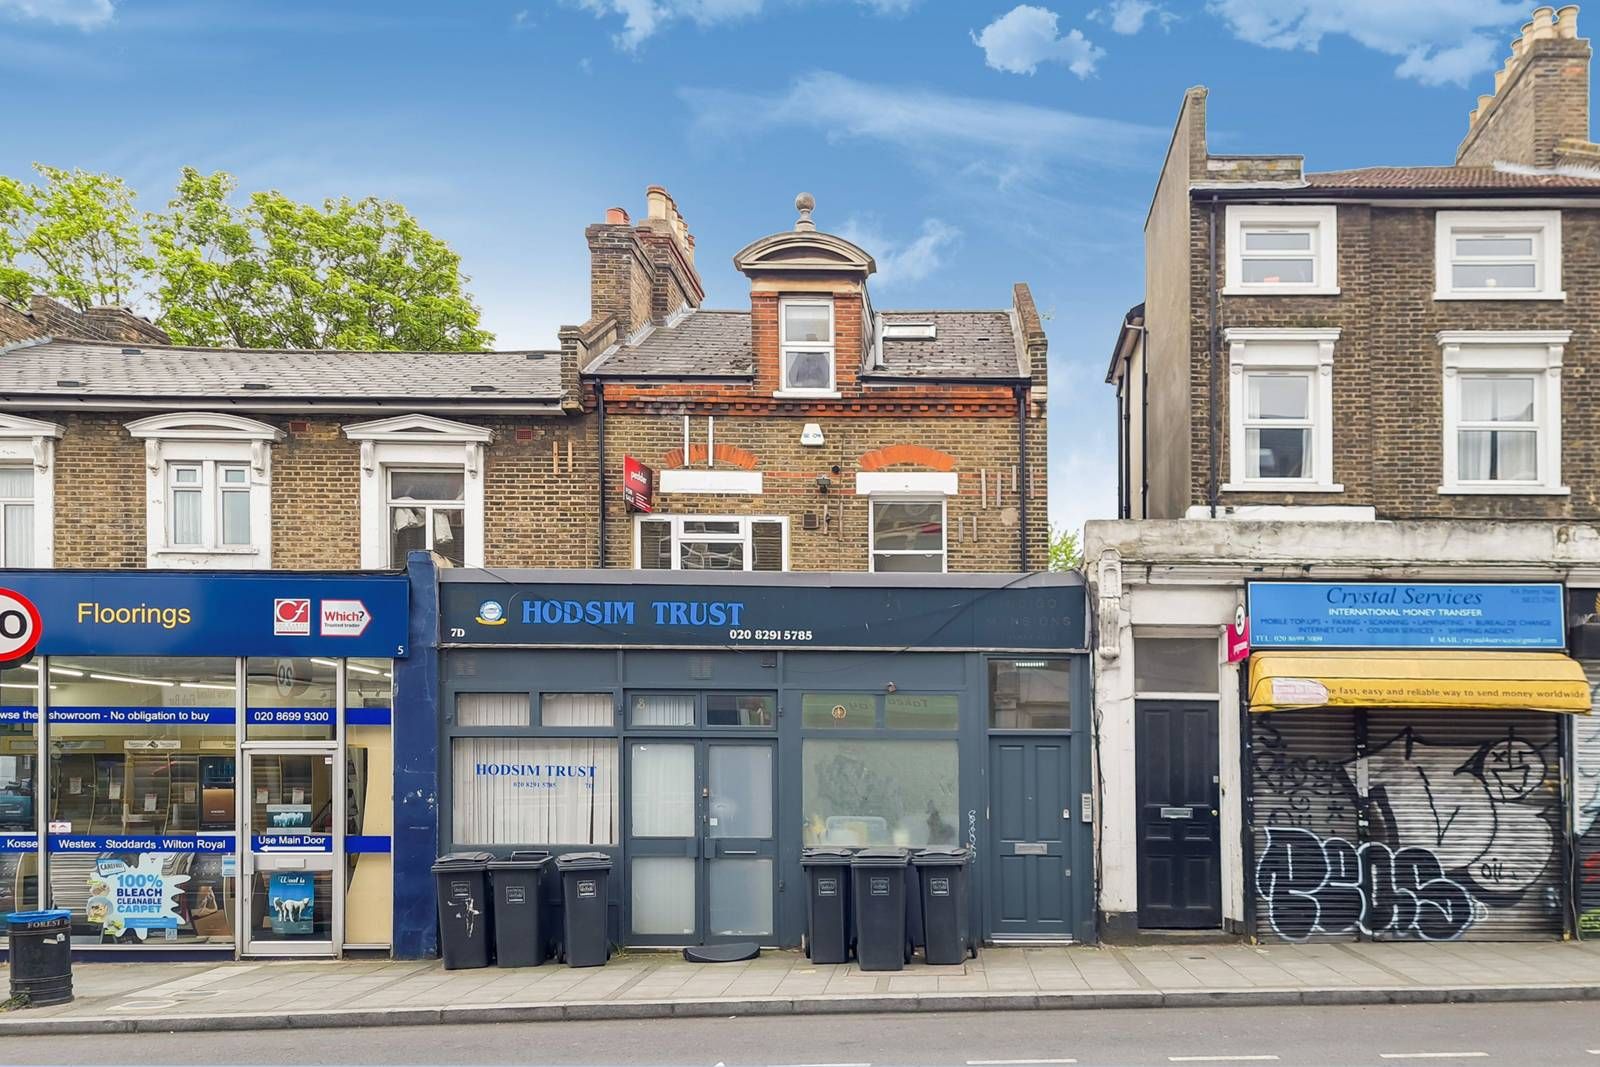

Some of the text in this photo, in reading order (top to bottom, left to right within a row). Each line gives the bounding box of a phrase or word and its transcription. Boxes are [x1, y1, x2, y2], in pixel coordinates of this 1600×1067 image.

[1326, 587, 1483, 608] Crystal Services
[77, 602, 192, 629] Floorings
[324, 611, 365, 622] Which?
[522, 600, 635, 625] HODSIM
[652, 601, 744, 626] TRUST
[1328, 608, 1483, 617] INTERNATIONAL MONEY TRANSFER
[450, 628, 466, 638] 7D
[730, 630, 812, 640] 020 8291 5785
[397, 645, 404, 655] 5
[1387, 687, 1403, 695] and
[1407, 688, 1440, 696] reliable
[1537, 691, 1585, 699] worldwide
[23, 711, 38, 720] the
[49, 711, 100, 720] showroom
[110, 711, 125, 720] No
[128, 711, 176, 722] obligation
[179, 711, 188, 720] to
[191, 711, 210, 722] buy
[254, 711, 329, 721] 020 8699 9300
[476, 763, 597, 777] HODSIM TRUST
[59, 840, 97, 849] Westex
[105, 840, 156, 849] Stoddards
[163, 840, 194, 849] Wilton
[197, 840, 226, 851] Royal
[258, 836, 326, 845] Use Main Door
[117, 874, 163, 888] 100%
[117, 888, 162, 897] BLEACH
[117, 905, 161, 913] CARPET
